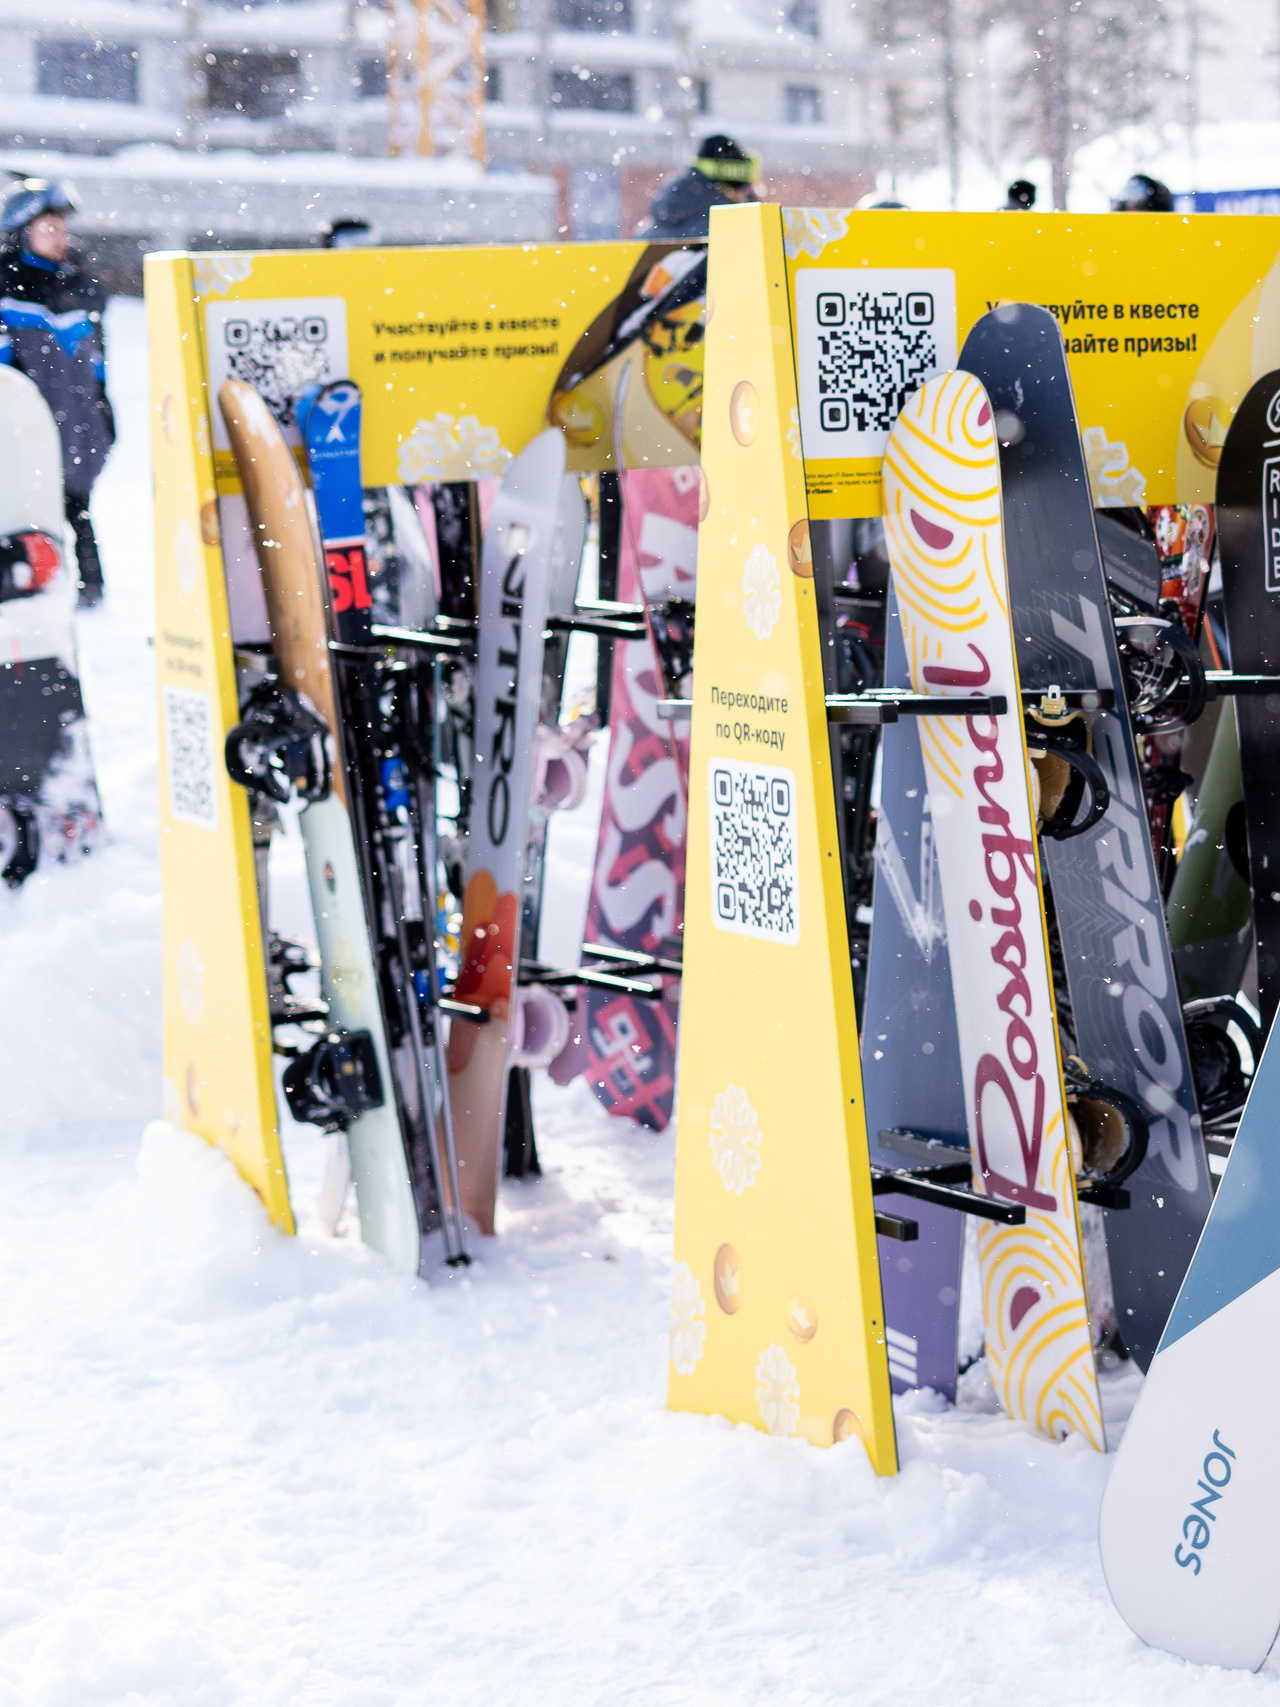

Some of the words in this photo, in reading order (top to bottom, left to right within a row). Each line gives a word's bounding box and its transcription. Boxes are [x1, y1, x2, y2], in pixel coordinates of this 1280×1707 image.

[1113, 304, 1125, 319] в
[1130, 303, 1200, 319] квесте
[1124, 334, 1198, 357] призы!
[711, 686, 788, 714] Переходите
[715, 723, 731, 739] по
[733, 722, 786, 751] QR-коду
[1050, 594, 1201, 1194] TERROR
[922, 643, 1058, 1213] Rossignol
